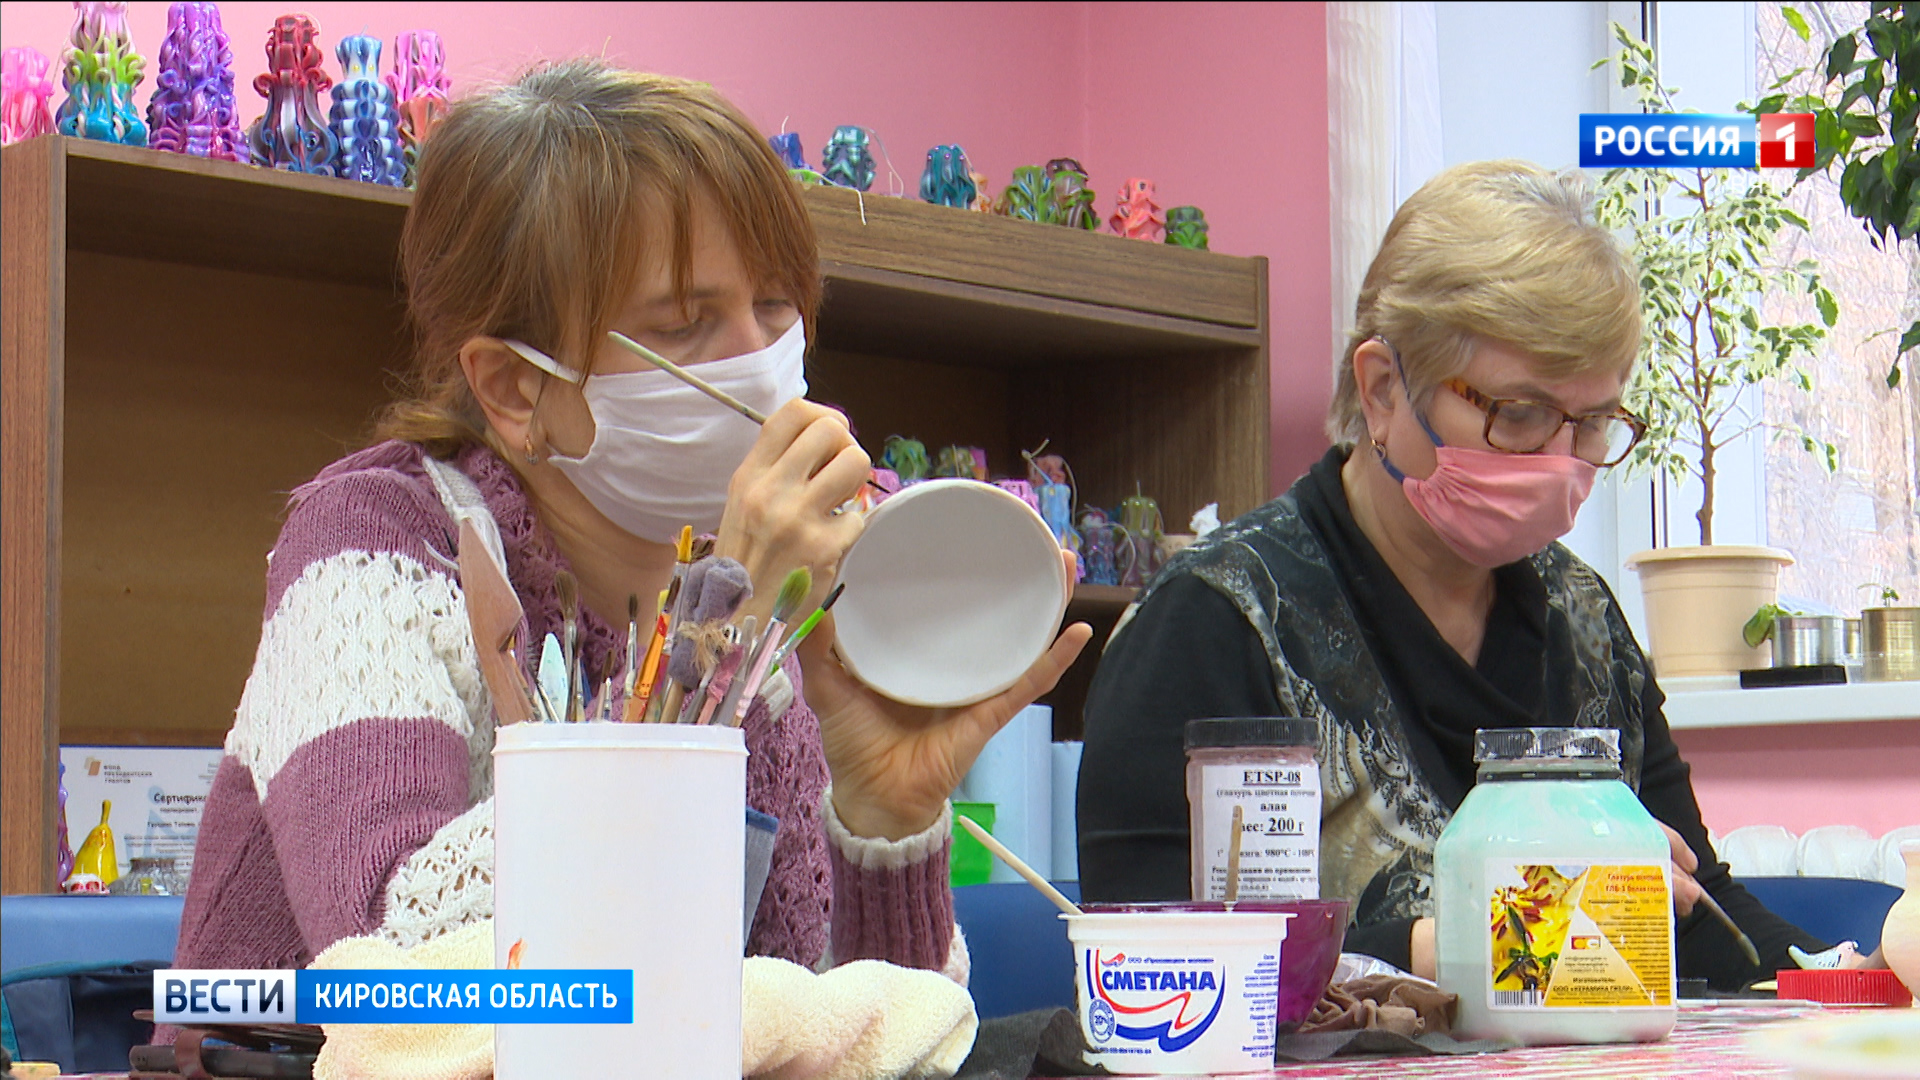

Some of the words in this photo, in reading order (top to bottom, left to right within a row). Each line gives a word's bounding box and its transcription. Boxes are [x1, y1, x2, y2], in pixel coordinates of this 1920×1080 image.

[1243, 770, 1301, 784] ETSP-08
[1268, 816, 1295, 832] 200
[1101, 970, 1217, 991] СМЕТАНА
